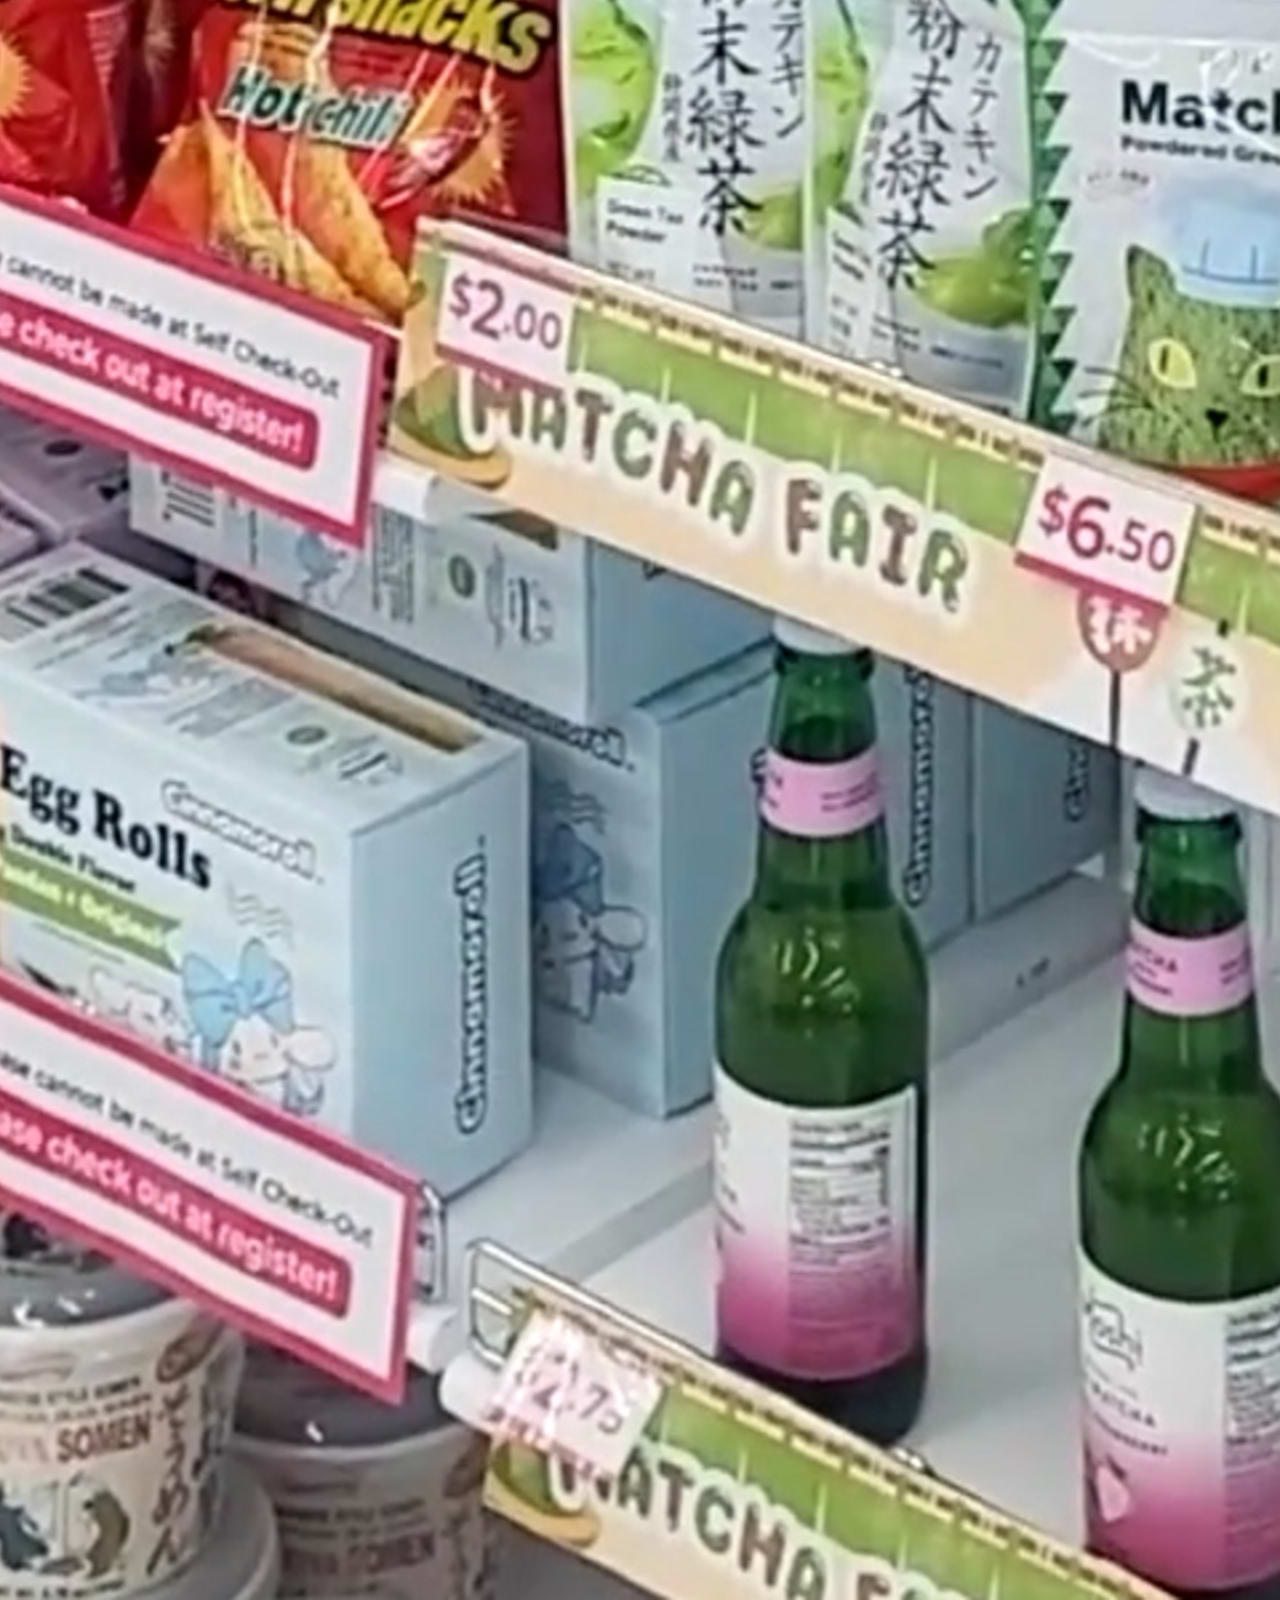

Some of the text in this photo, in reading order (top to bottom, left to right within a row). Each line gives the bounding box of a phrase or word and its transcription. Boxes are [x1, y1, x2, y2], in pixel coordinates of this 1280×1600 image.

[224, 66, 413, 147] Hot chili
[961, 33, 1004, 202] カテキン
[447, 275, 563, 351] $2.00
[22, 315, 100, 367] check
[104, 350, 148, 389] out
[154, 368, 184, 400] at
[189, 381, 304, 453] register!
[468, 374, 971, 616] MATCHA FAIR
[1040, 486, 1176, 574] $6.50
[0, 741, 212, 891] Egg Rolls
[33, 1058, 107, 1115] cannot
[48, 1124, 129, 1188] check
[136, 1166, 182, 1218] out
[185, 1200, 216, 1232] at
[219, 1218, 340, 1299] register!
